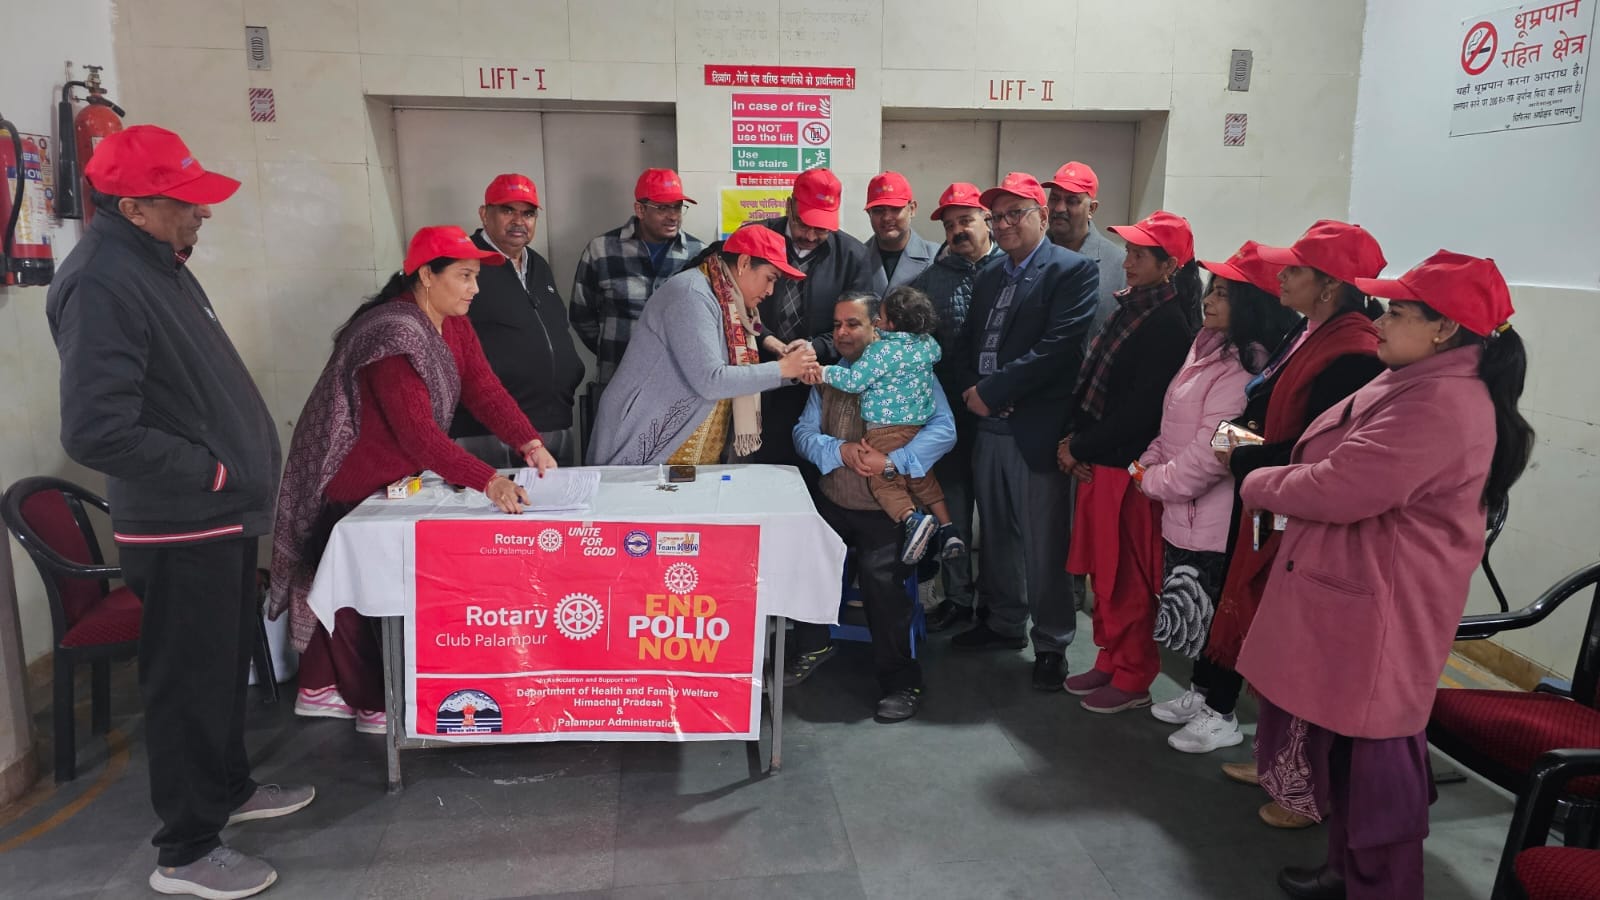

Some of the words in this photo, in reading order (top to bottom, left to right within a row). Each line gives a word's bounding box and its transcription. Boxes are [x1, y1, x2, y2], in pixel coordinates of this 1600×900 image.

[1514, 0, 1581, 38] धूम्रपान
[1501, 42, 1543, 68] रहित
[1552, 30, 1587, 62] क्षेत्र
[1507, 75, 1530, 86] करना
[1534, 68, 1568, 82] अपराध
[733, 101, 745, 111] In
[748, 103, 778, 112] case
[781, 101, 794, 112] of
[796, 102, 817, 112] fire
[737, 124, 754, 133] DO
[757, 124, 782, 133] NOT
[737, 134, 757, 142] use
[759, 133, 777, 142] the
[779, 133, 794, 142] lift
[737, 150, 759, 159] Use
[738, 159, 756, 168] the
[758, 159, 788, 168] stairs
[568, 527, 601, 537] UNITE
[494, 533, 535, 546] Rotary
[580, 537, 603, 546] FOR
[480, 547, 497, 555] Club
[499, 547, 535, 556] Palampur
[583, 547, 616, 556] GOOD
[645, 594, 718, 618] END
[465, 605, 548, 629] Rotary
[628, 615, 730, 641] POLIO
[435, 633, 472, 647] Club
[475, 633, 548, 650] Palampur
[638, 637, 721, 663] NOW
[516, 687, 576, 699] Department
[578, 687, 588, 695] of
[591, 687, 623, 696] Health
[625, 687, 645, 696] and
[647, 687, 679, 698] Family
[682, 688, 719, 698] Welfare
[573, 698, 620, 707] Himachal
[623, 698, 663, 708] Pradesh
[616, 707, 624, 715] &
[557, 718, 606, 730] Palampur
